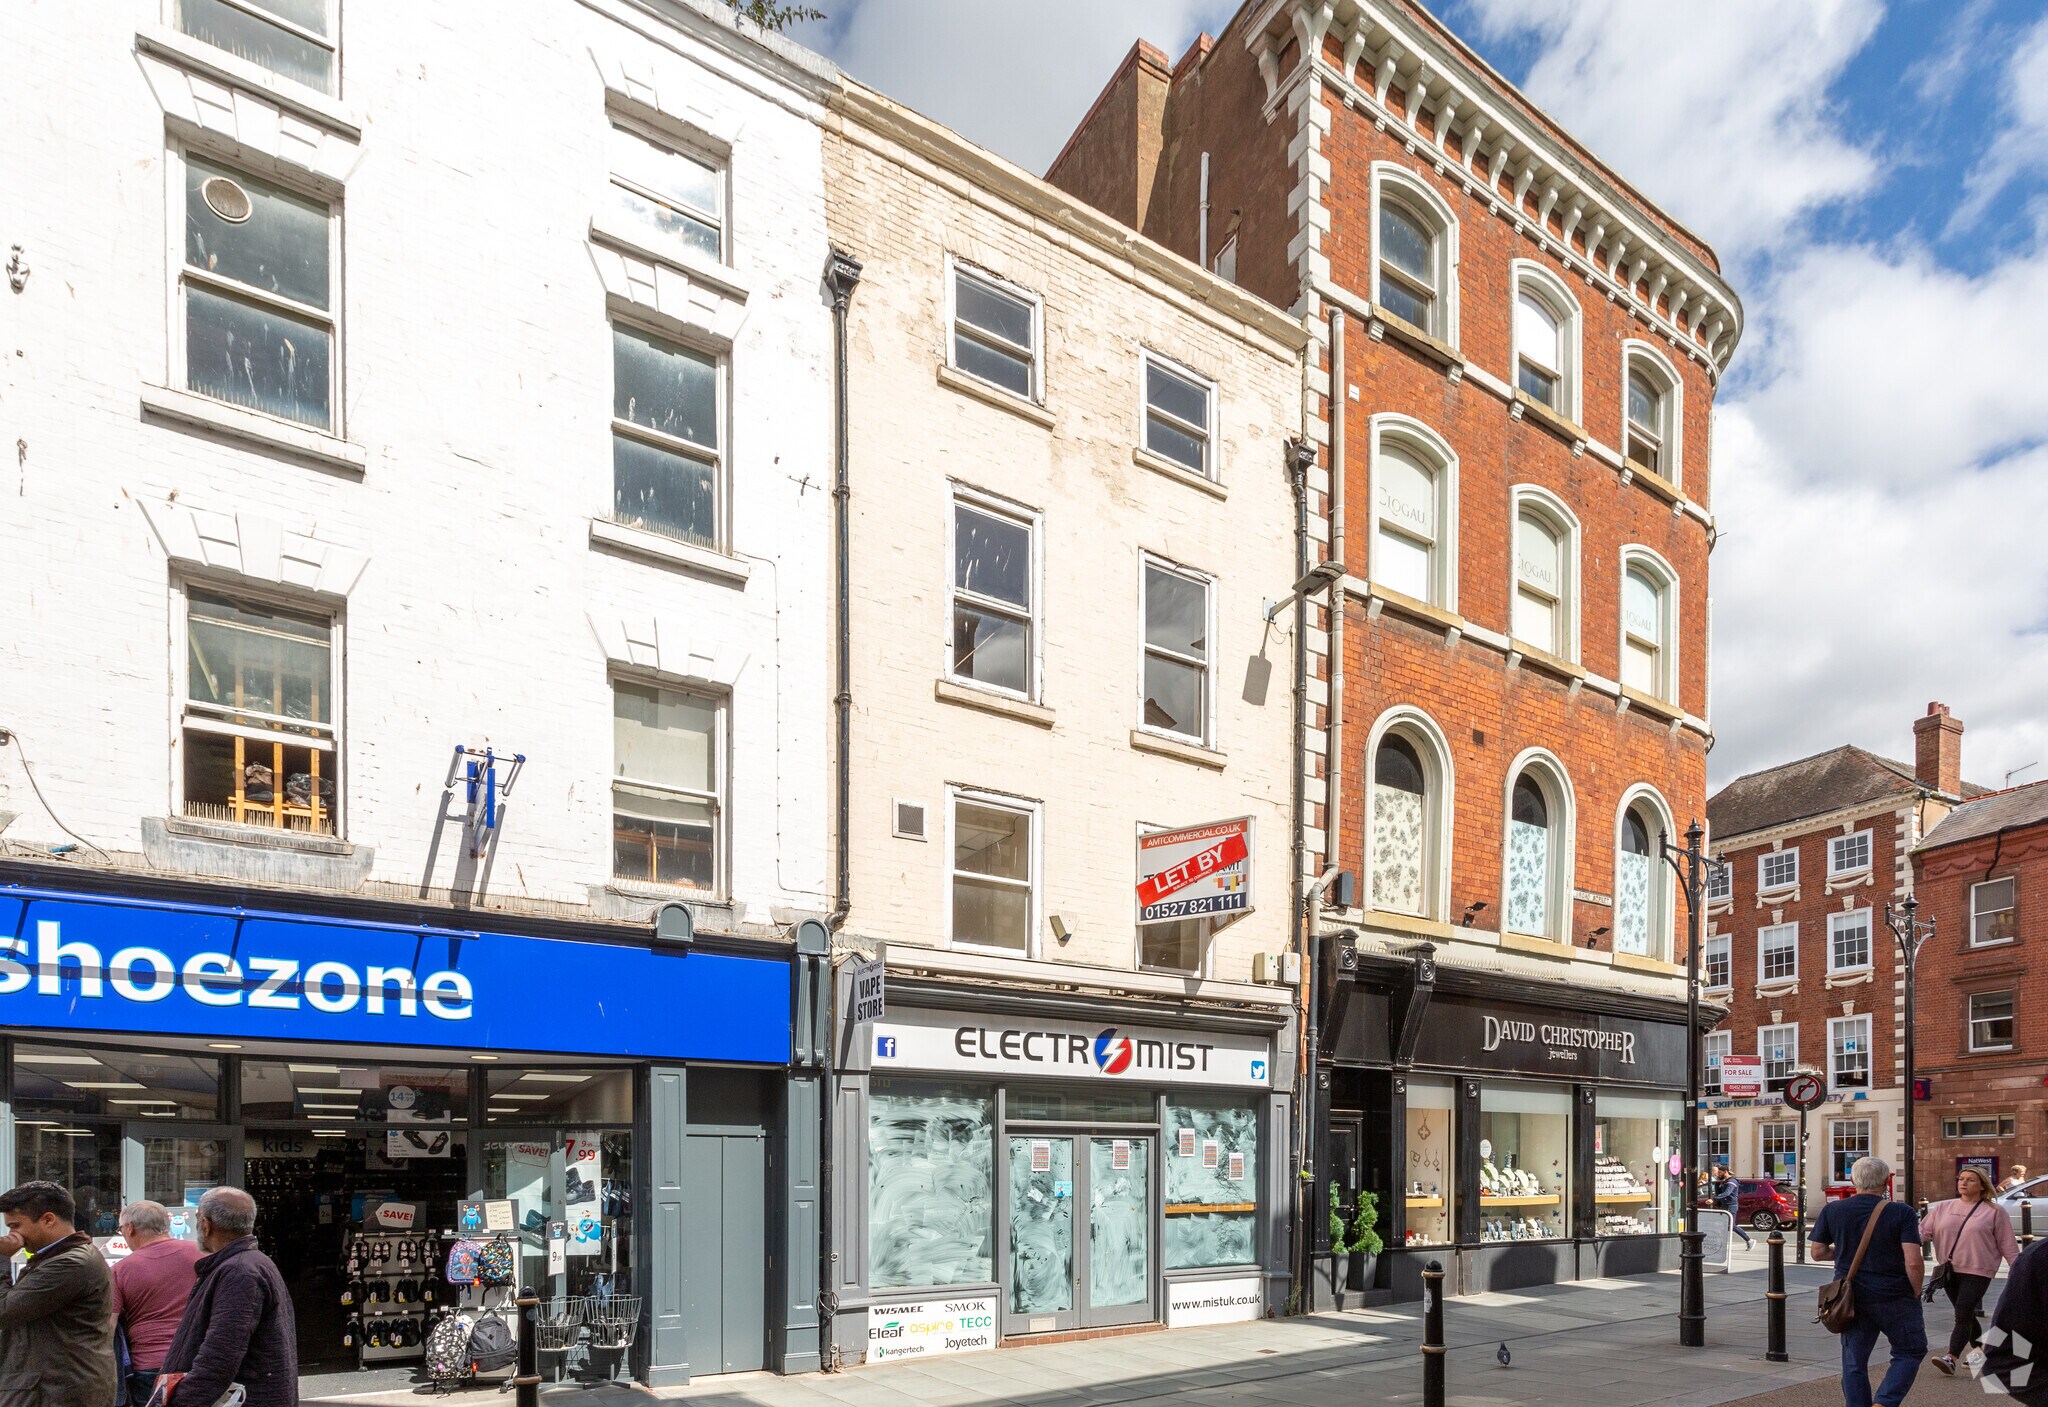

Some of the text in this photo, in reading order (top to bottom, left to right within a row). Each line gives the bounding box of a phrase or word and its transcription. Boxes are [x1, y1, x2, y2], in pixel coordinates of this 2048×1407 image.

[1147, 824, 1241, 847] AMTCOMMERCIAL.CO.UK
[1154, 845, 1223, 894] LET BY
[1145, 894, 1241, 919] 01527 821 111
[0, 919, 474, 1021] shoezone
[859, 975, 881, 999] VAPE
[857, 998, 882, 1020] STORE
[1548, 1048, 1578, 1061] jewellers
[1713, 1097, 1785, 1109] SKIPTON BUILD
[263, 1134, 304, 1153] kids
[518, 1144, 549, 1158] SAVE!
[383, 1210, 414, 1221] SAVE!
[873, 1301, 986, 1316] WISMEC SMOK
[1172, 1294, 1261, 1310] www.mistuk.co.uk
[869, 1325, 904, 1340] Eleaf
[959, 1316, 992, 1329] TECC
[885, 1335, 987, 1357] kangertech Joyetech
